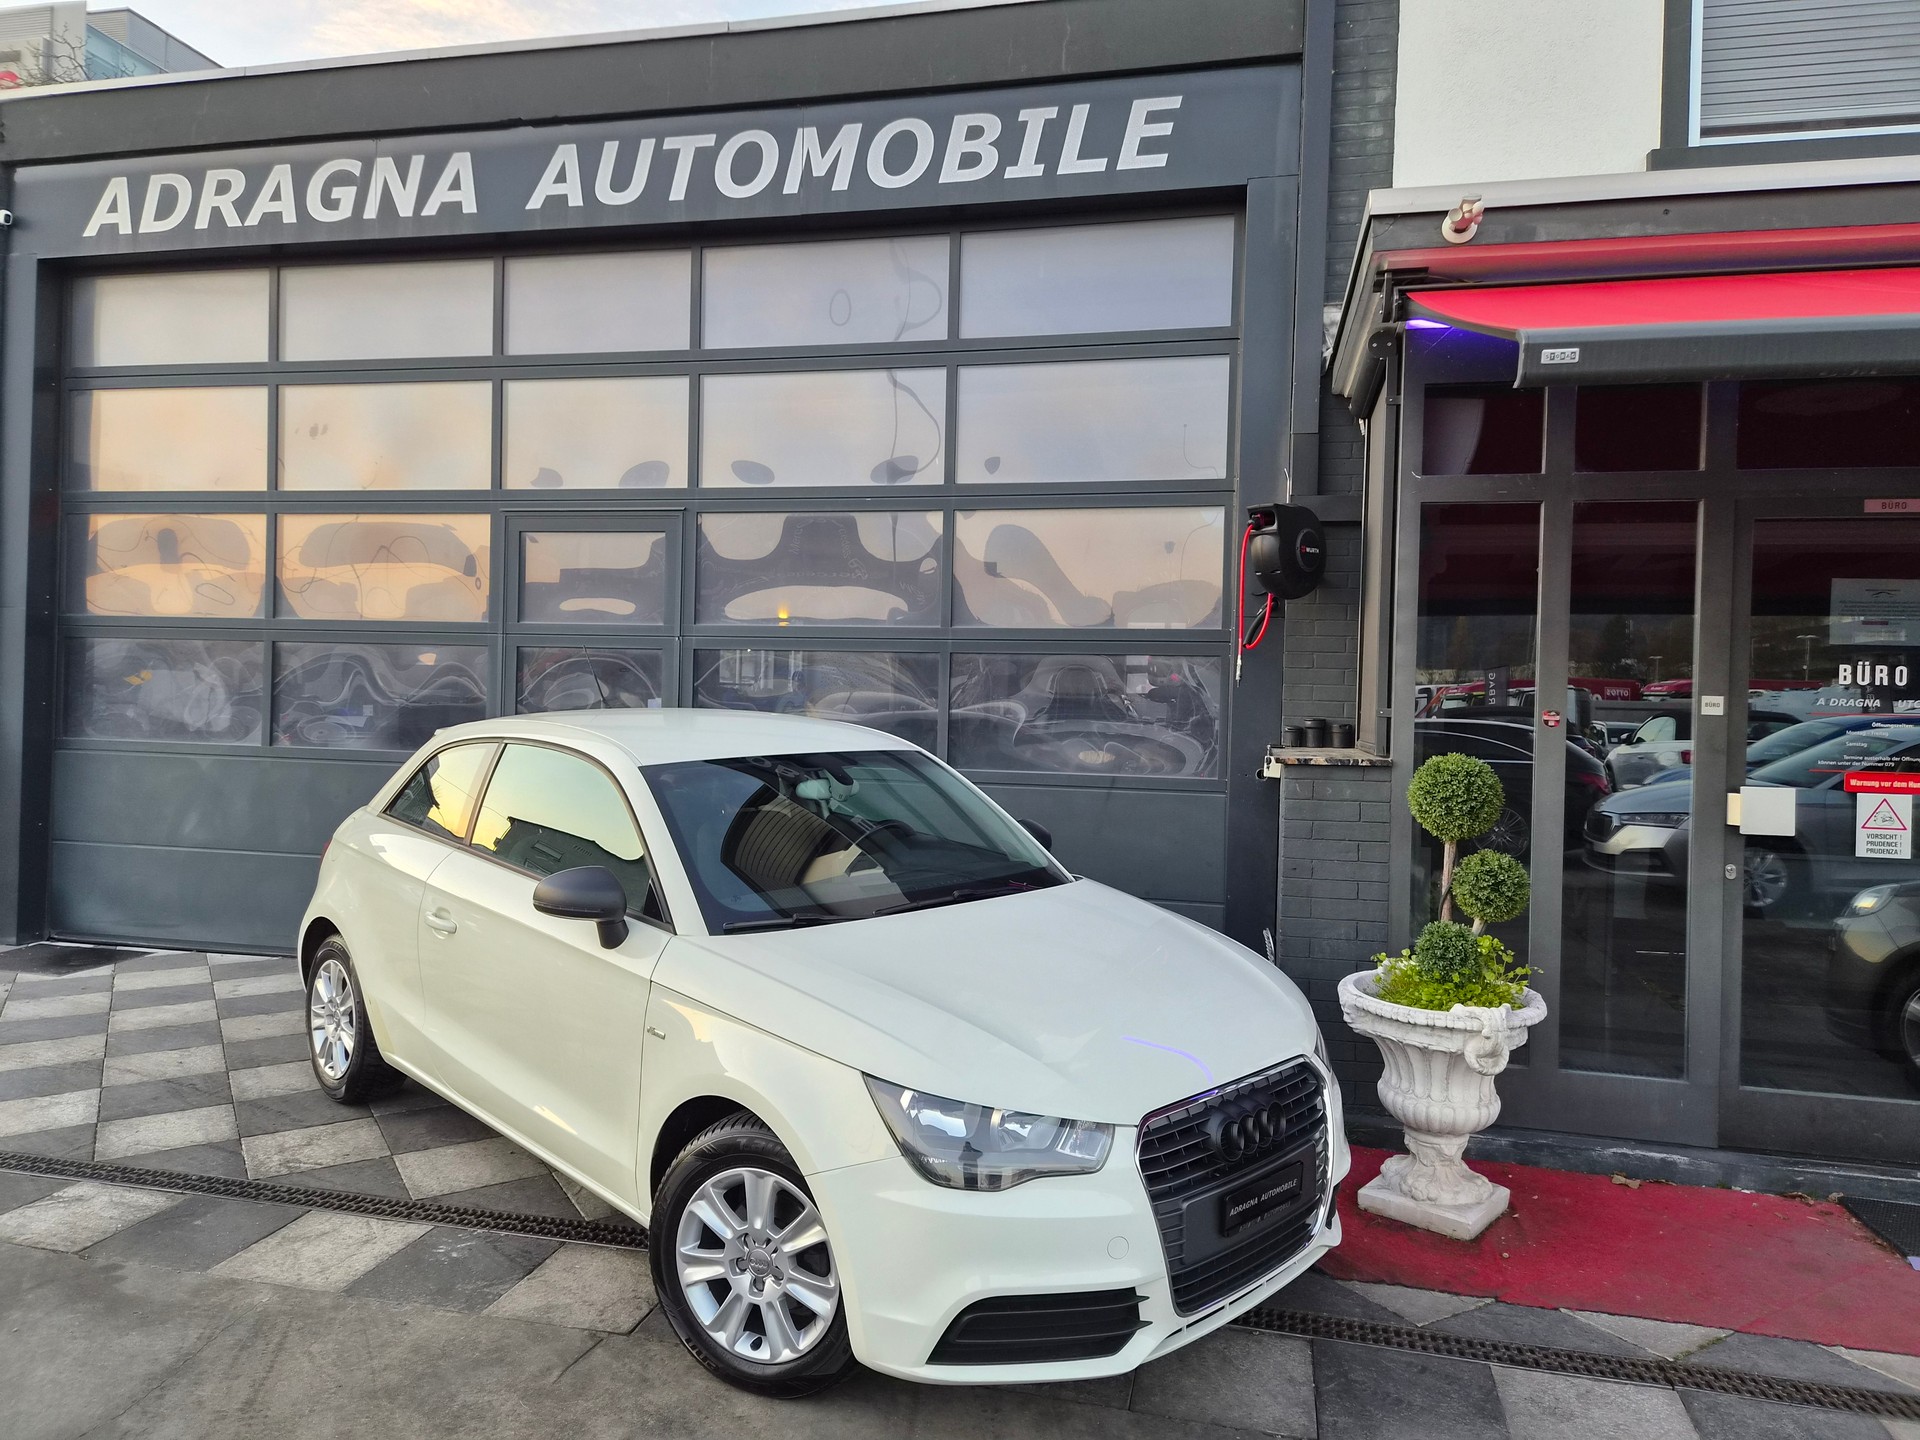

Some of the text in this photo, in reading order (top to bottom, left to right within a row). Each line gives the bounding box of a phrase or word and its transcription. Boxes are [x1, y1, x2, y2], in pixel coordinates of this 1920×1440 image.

[82, 95, 1183, 238] ADRAGNA AUTOMOBILE
[1881, 500, 1907, 510] BÜRO
[1838, 661, 1908, 686] BÜRO
[1849, 779, 1880, 788] Warnung
[1893, 780, 1908, 788] dem
[1229, 1196, 1258, 1217] ADRAGNA
[1260, 1178, 1298, 1202] AUTOMOBILE
